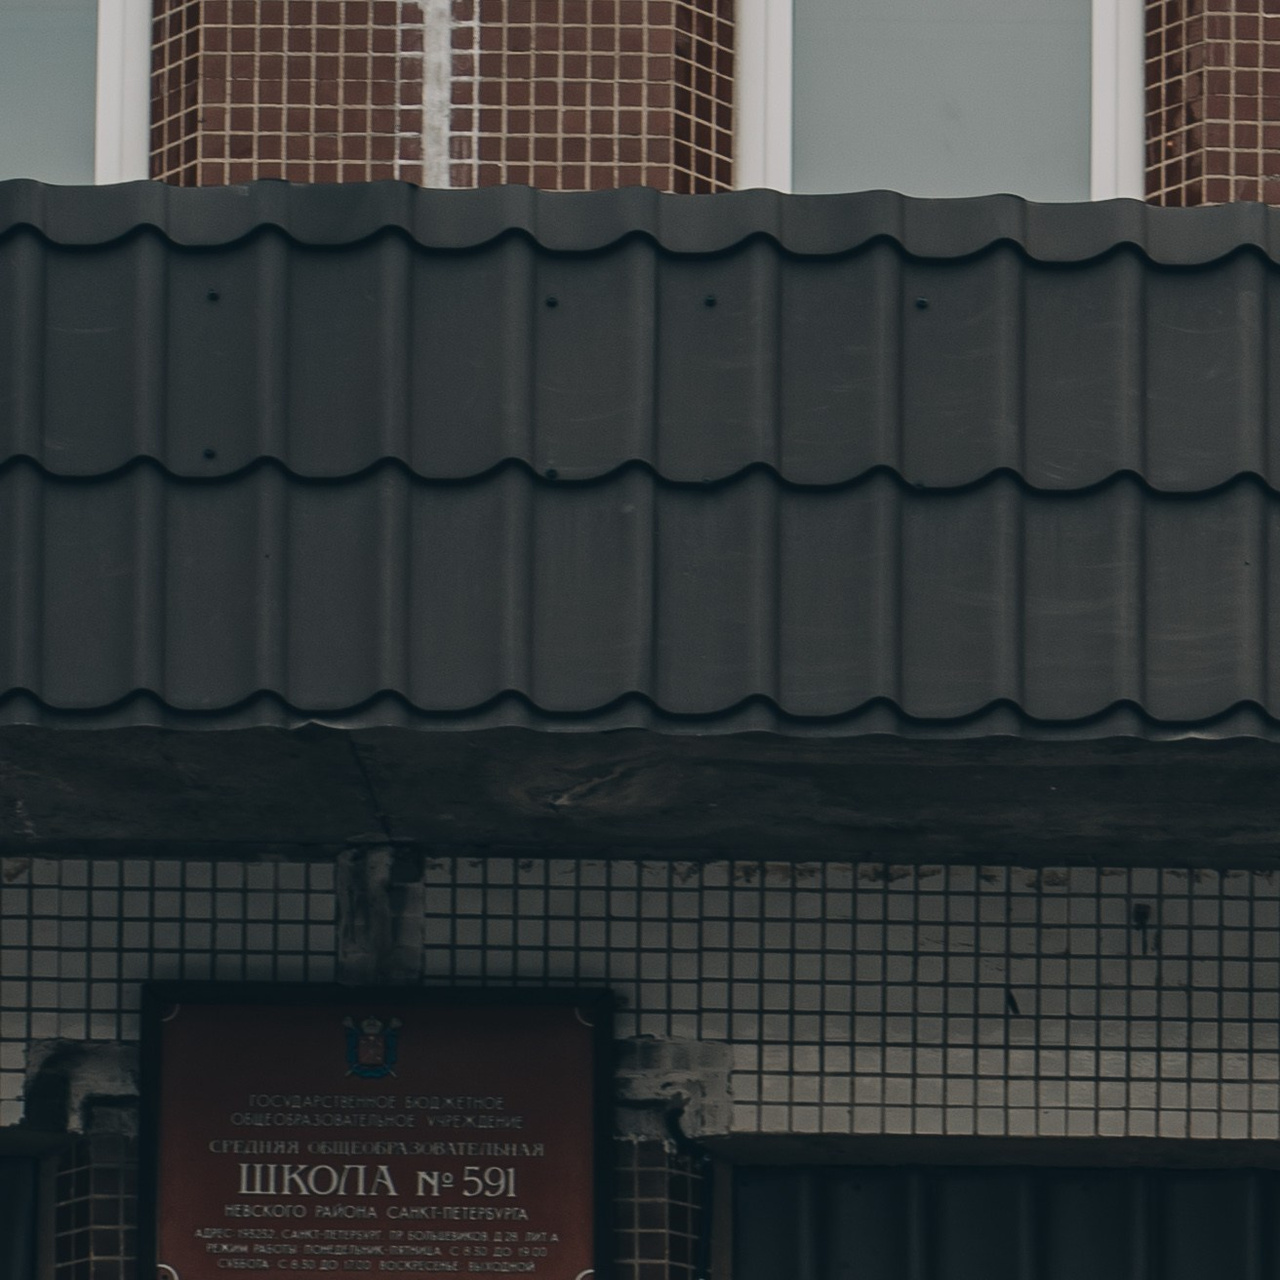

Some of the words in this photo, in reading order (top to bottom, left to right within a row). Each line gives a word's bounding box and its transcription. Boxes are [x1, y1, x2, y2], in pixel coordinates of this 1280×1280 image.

[248, 1094, 397, 1109] ГОСУДАРСТВЕННОЕ
[404, 1095, 505, 1111] БЮДЖЕТНОЕ
[230, 1112, 416, 1128] ОБЩЕОБРАЗОВАТЕЛЬНОЕ
[426, 1114, 525, 1130] УЧРЕЖДЕНИЕ
[208, 1139, 300, 1155] СРЕДНЯЯ
[307, 1140, 545, 1157] ОБЩЕОБРАЗОВАТЕЛЬНАЯ
[237, 1162, 400, 1197] ШКОЛА
[461, 1165, 518, 1198] 591
[223, 1204, 308, 1218] НЕВСКОГО
[314, 1203, 379, 1220] РАЙОНА
[385, 1205, 530, 1222] САНКТ-ПЕТЕРБУРГА
